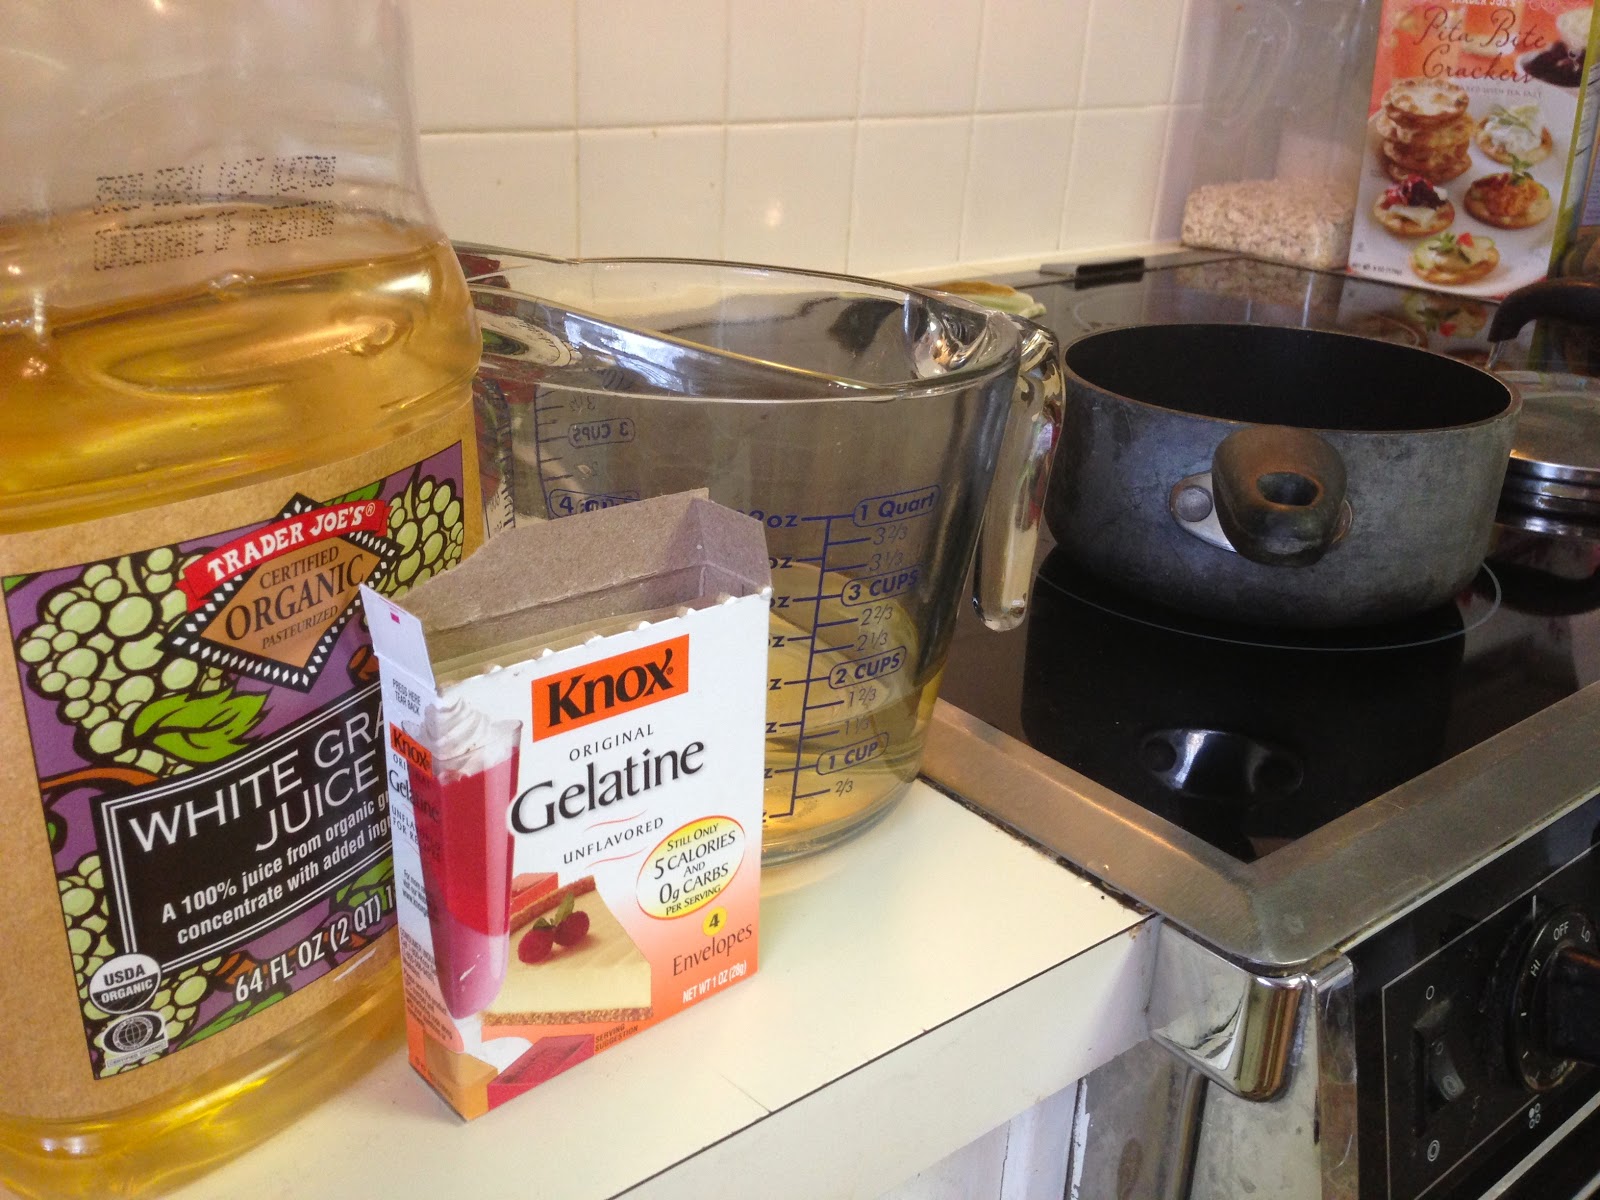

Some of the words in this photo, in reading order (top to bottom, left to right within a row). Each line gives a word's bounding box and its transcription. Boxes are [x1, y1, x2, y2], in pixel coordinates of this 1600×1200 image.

[1413, 6, 1474, 45] Pita
[1480, 8, 1546, 49] Bite
[1422, 43, 1534, 84] Crackers
[559, 496, 574, 513] 4
[860, 504, 869, 521] 1
[878, 492, 935, 518] Quart
[207, 522, 304, 581] TRADER
[260, 545, 340, 589] CERTIFIED
[225, 554, 364, 641] ORGANIC
[849, 584, 861, 600] 3
[869, 568, 919, 596] CUPS
[262, 605, 338, 649] PASTEURIZED
[547, 648, 674, 727] Knox
[834, 668, 847, 685] 2
[854, 652, 900, 680] CUPS
[407, 700, 420, 716] BACK
[408, 689, 421, 706] HERE
[393, 729, 428, 770] Knox
[569, 723, 654, 761] ORIGINAL
[828, 755, 836, 770] 1
[843, 741, 878, 765] CUP
[129, 749, 302, 852] WHITE
[255, 749, 379, 851] JUICE
[510, 740, 705, 835] Gelatine
[393, 818, 406, 834] FOR
[563, 817, 664, 864] UNFLAVORED
[667, 835, 692, 852] STILL
[693, 823, 719, 840] ONLY
[162, 903, 177, 923] A
[181, 878, 237, 914] 100%
[242, 857, 283, 893] juice
[286, 832, 322, 866] from
[325, 799, 375, 842] organic
[654, 857, 665, 880] 5
[667, 830, 736, 870] CALORIES
[683, 861, 705, 877] AND
[177, 886, 283, 945] concentrate
[287, 862, 319, 891] with
[323, 835, 365, 870] added
[659, 882, 679, 904] 0g
[683, 862, 729, 893] CARBS
[666, 902, 682, 916] PER
[684, 885, 721, 908] SERVING
[708, 913, 720, 928] 4
[1553, 921, 1569, 940] OFF
[1581, 925, 1591, 943] LO
[235, 967, 263, 1002] 64
[270, 954, 293, 985] FL
[298, 932, 325, 968] OZ
[330, 917, 350, 952] (2
[353, 894, 381, 932] QT)
[673, 924, 753, 976] Envelopes
[103, 964, 146, 986] USDA
[682, 984, 698, 1003] NET
[698, 978, 711, 994] WT
[711, 976, 717, 988] 1
[718, 969, 728, 985] OZ
[729, 960, 747, 982] (28g)
[1530, 959, 1541, 977] HI
[101, 979, 153, 1003] ORGANIC
[594, 1025, 639, 1052] SUGGESTION
[596, 1022, 625, 1043] SERVING
